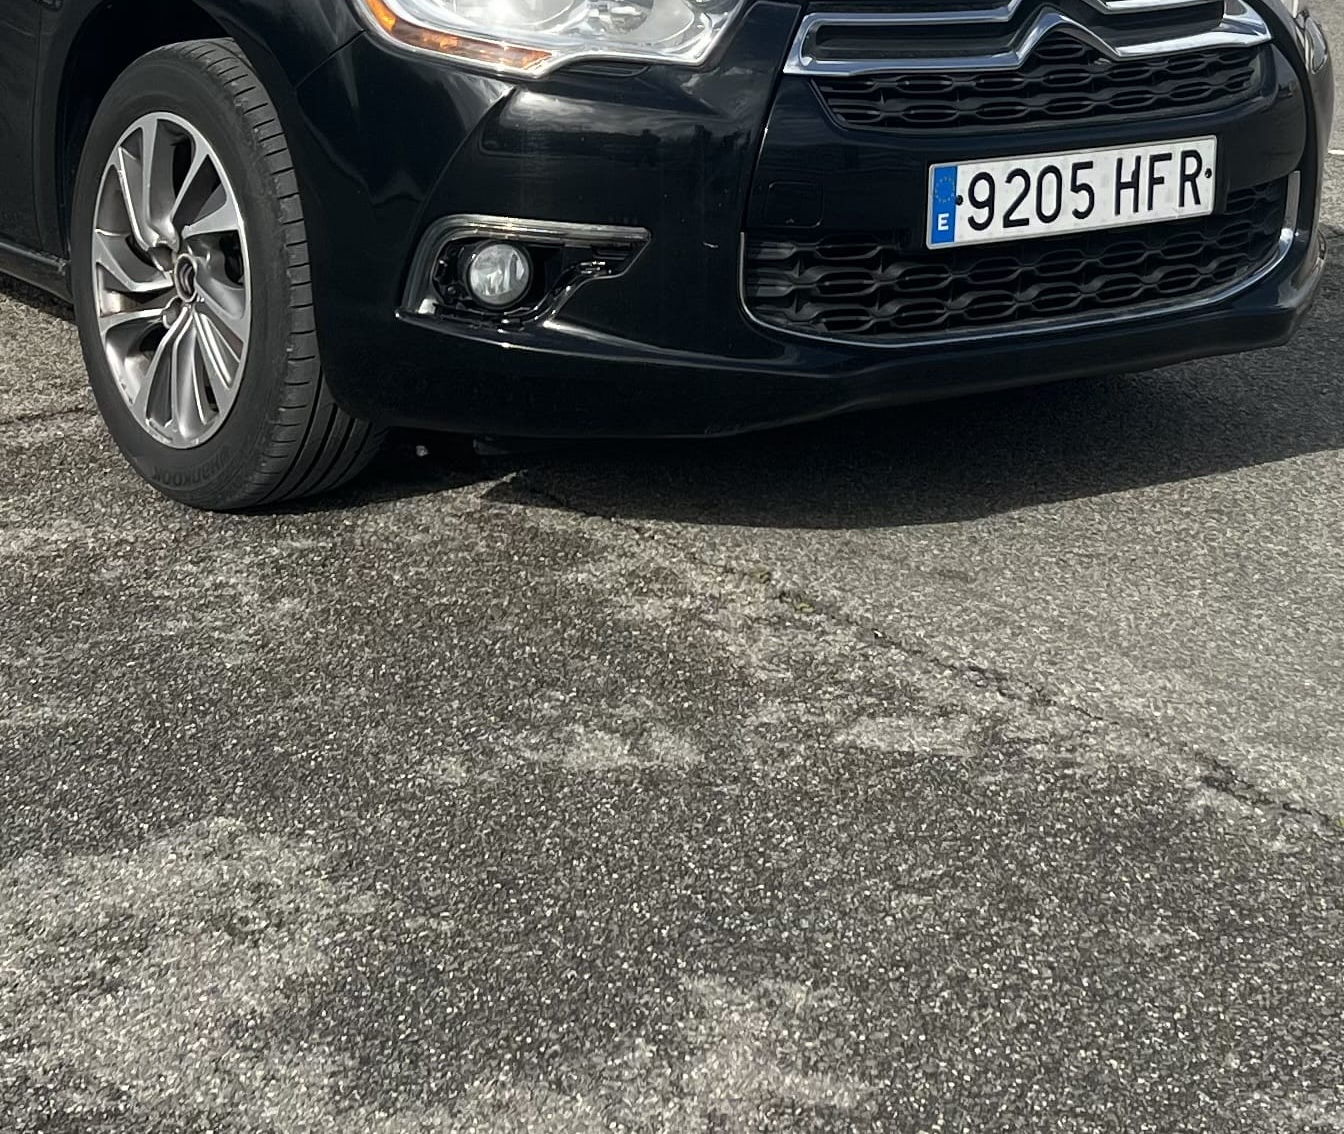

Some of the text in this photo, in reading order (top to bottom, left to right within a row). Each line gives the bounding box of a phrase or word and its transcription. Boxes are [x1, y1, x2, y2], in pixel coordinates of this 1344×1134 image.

[967, 149, 1203, 231] 9205 HFR
[937, 213, 949, 230] E
